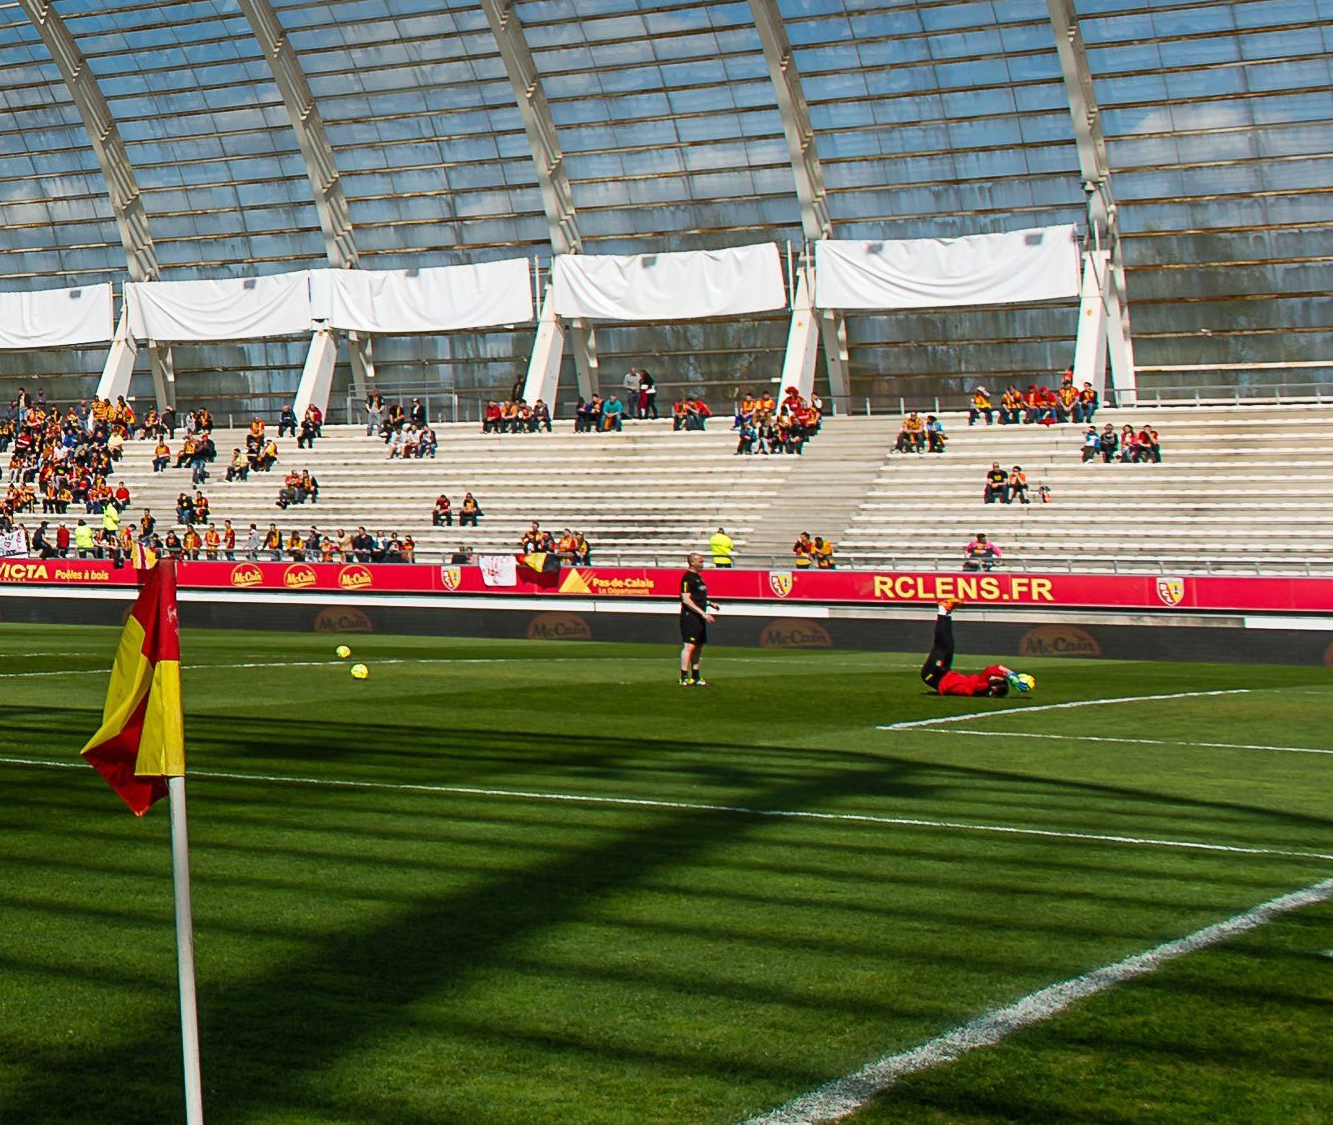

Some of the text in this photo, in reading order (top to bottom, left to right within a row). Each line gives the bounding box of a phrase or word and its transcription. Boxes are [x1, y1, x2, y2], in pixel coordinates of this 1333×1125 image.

[84, 569, 89, 580] à
[91, 570, 109, 580] bois
[234, 570, 262, 583] McCain
[286, 571, 315, 584] McCain
[341, 572, 372, 585] McCain
[593, 578, 654, 588] Pas-de-Calais
[874, 576, 1054, 601] RCLENS.FR
[321, 616, 367, 630] McCain
[534, 622, 587, 638] McCain
[766, 630, 825, 645] McCain
[1026, 636, 1094, 654] McCain
